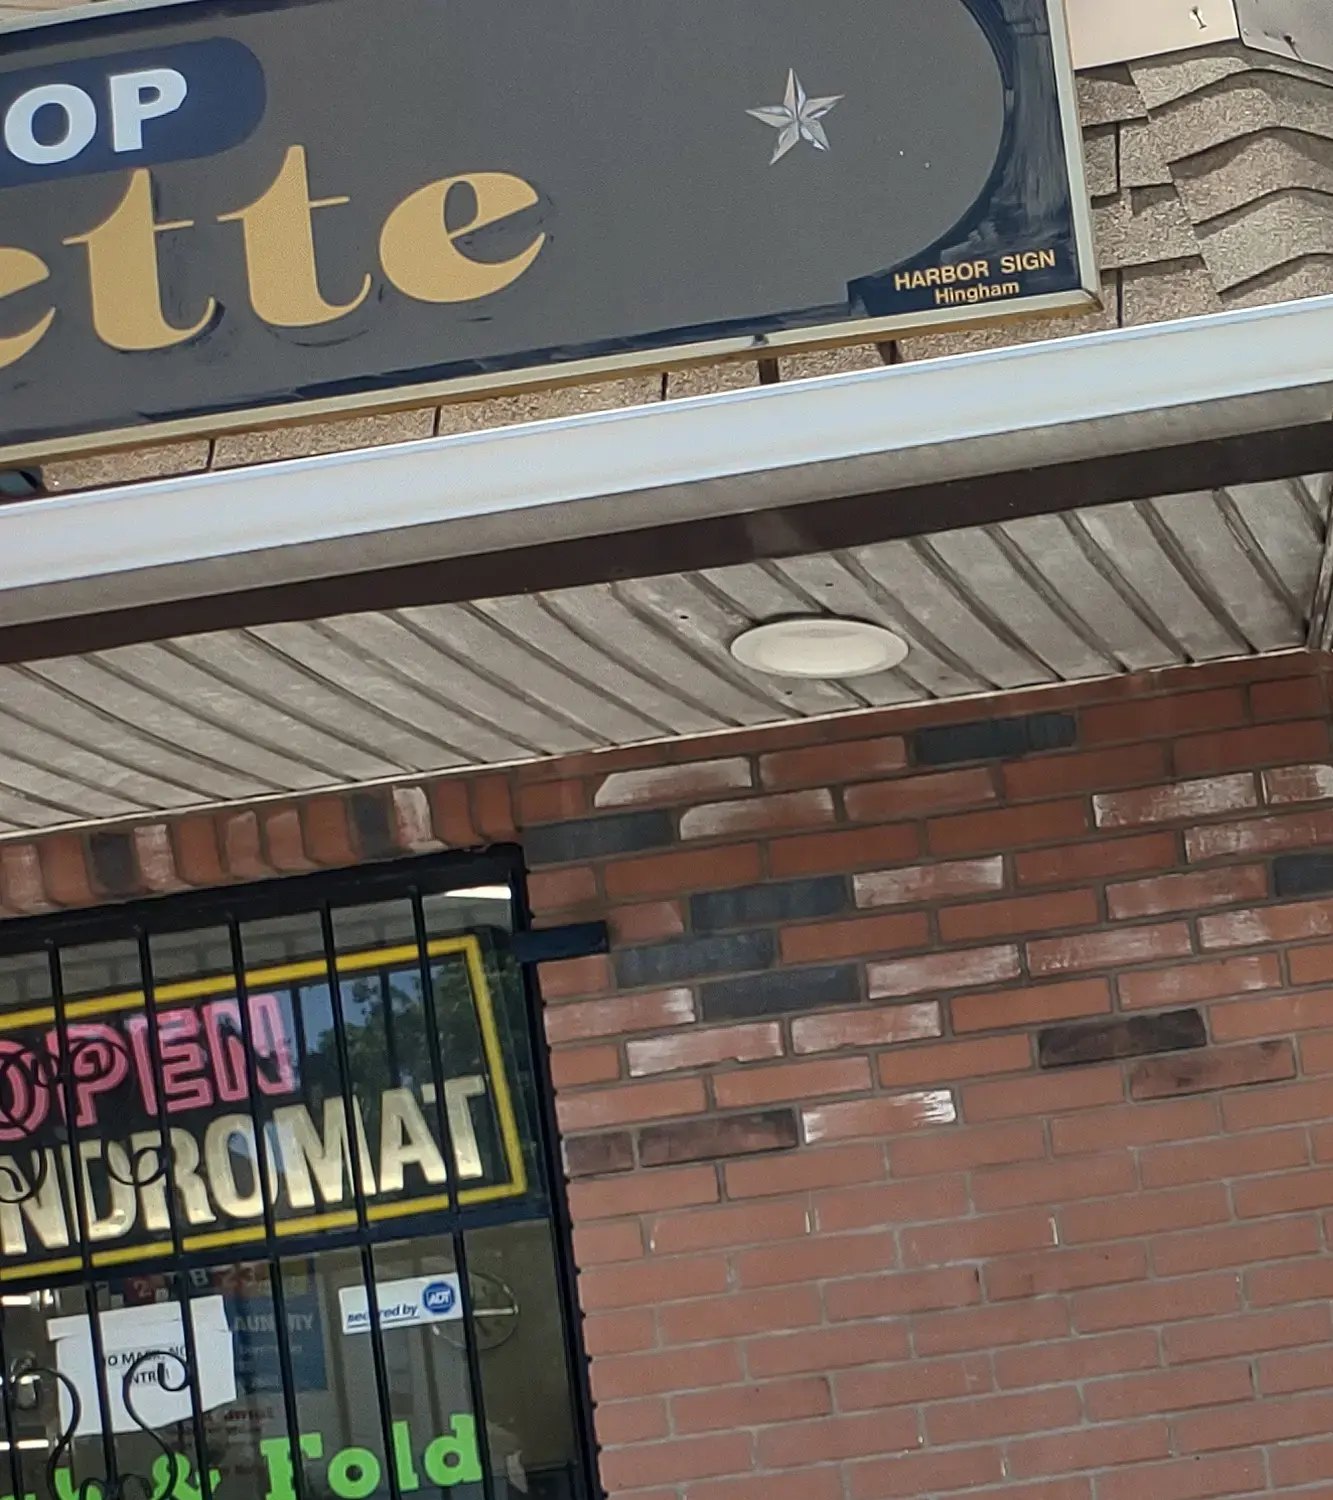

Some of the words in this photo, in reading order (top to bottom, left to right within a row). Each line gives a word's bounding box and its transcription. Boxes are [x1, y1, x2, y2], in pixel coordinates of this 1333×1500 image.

[5, 68, 187, 164] OP
[894, 260, 990, 291] HARBOR
[1000, 249, 1056, 274] SIGN
[935, 282, 1020, 304] Hingham
[0, 994, 295, 1141] OPEN
[0, 1075, 486, 1256] NDROMAT
[402, 1303, 418, 1317] by
[429, 1290, 450, 1304] ADT
